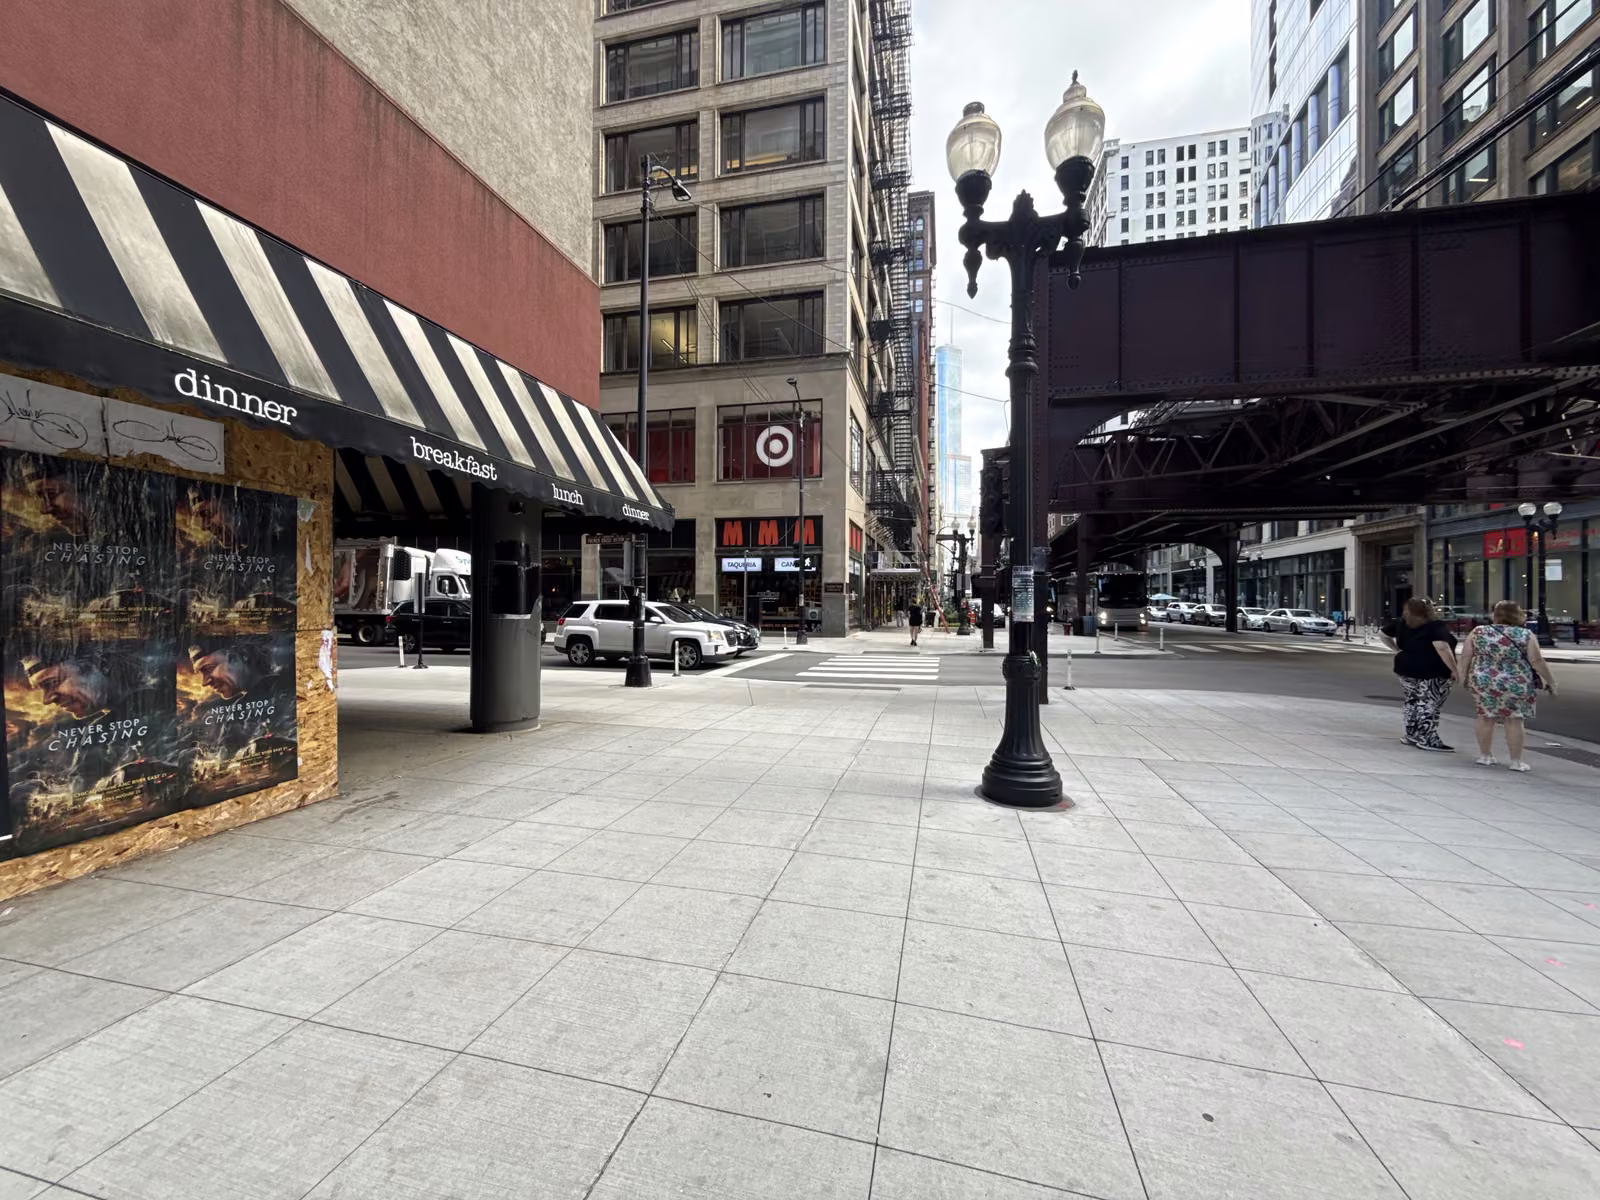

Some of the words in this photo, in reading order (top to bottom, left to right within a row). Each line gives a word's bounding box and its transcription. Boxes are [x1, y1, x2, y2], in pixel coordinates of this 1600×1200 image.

[174, 368, 298, 425] dinner
[410, 436, 498, 481] breakfast
[551, 483, 584, 506] lunch
[622, 503, 650, 521] dinner
[53, 542, 99, 553] NEVER
[106, 545, 139, 555] STOP
[44, 551, 146, 566] CHASING
[203, 561, 276, 573] CHASING
[210, 553, 242, 563] NEVER
[246, 556, 270, 564] STOP
[727, 561, 757, 569] TAQURIA
[204, 706, 275, 725] CHASING
[211, 703, 243, 715] NEVER
[245, 700, 269, 710] STOP
[58, 724, 103, 739] NEVER
[109, 718, 140, 731] STOP
[48, 726, 148, 752] CHASING
